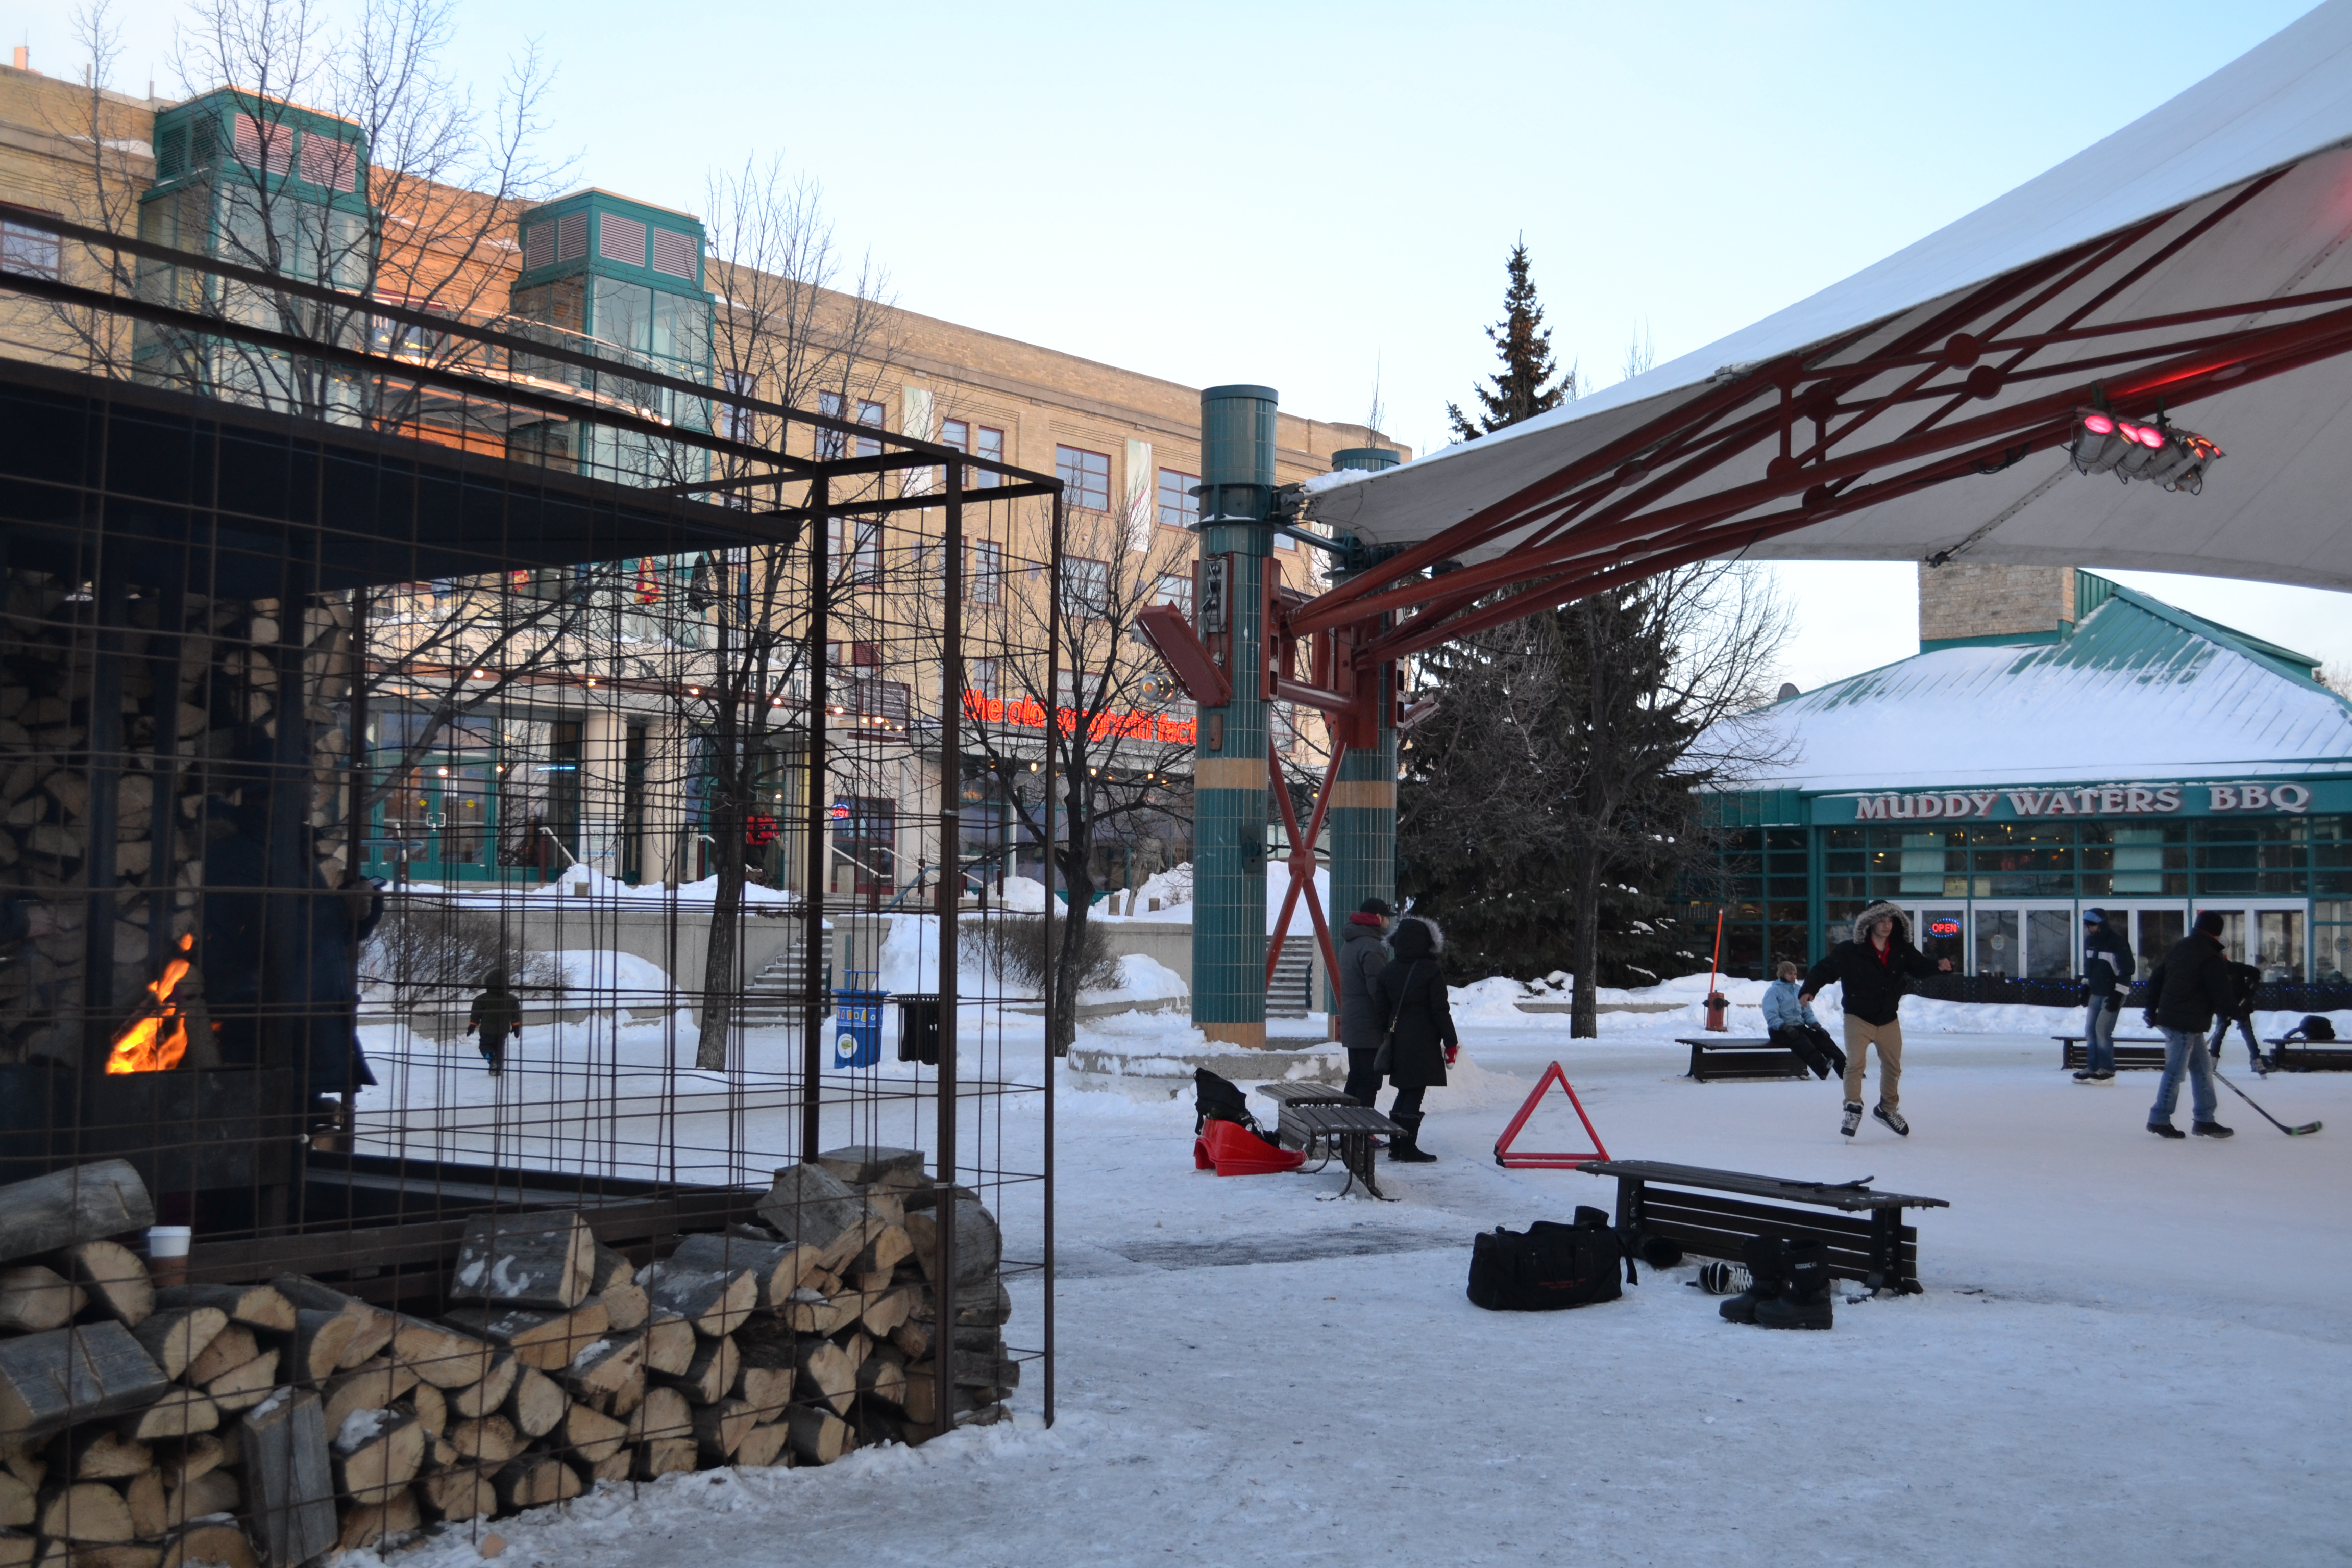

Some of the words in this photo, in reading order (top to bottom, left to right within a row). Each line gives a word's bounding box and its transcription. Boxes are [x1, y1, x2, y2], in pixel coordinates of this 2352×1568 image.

[1855, 793, 1996, 819] MUDDY
[2006, 788, 2181, 815] WATERS
[2208, 783, 2309, 813] BBQ
[1931, 923, 1957, 933] OPEN
